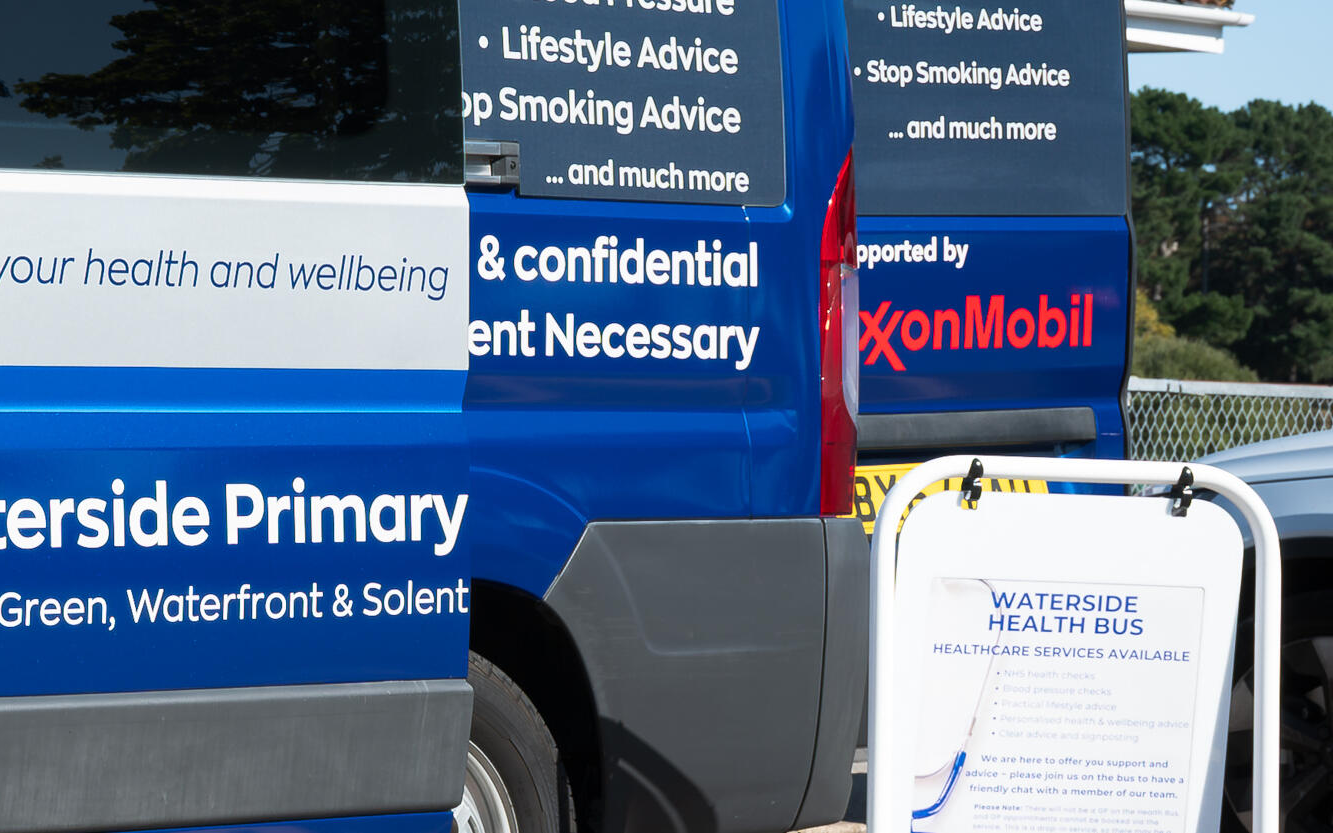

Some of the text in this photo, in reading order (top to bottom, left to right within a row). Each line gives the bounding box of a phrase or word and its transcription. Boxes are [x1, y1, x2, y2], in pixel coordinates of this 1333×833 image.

[890, 5, 1042, 34] Lifestyle Advice
[501, 24, 739, 74] Lifestyle Advice
[867, 59, 1070, 90] Stop Smoking Advice
[499, 86, 633, 135] Smoking
[639, 96, 741, 133] Advice
[907, 115, 945, 139] and
[949, 116, 1002, 139] much
[1006, 122, 1057, 141] more
[567, 159, 614, 186] and
[619, 162, 684, 189] much
[688, 170, 750, 192] more
[477, 234, 758, 287] & confidential
[943, 236, 969, 269] by
[84, 248, 198, 287] health
[210, 253, 279, 288] and
[289, 255, 449, 301] wellbeing
[545, 312, 761, 370] Necessary
[225, 477, 469, 556] Primary
[126, 582, 324, 625] Waterfront
[333, 584, 354, 617] &
[363, 578, 469, 616] Solent
[991, 592, 1138, 613] WATERSIDE
[988, 614, 1144, 635] HEALTH BUS
[933, 643, 1190, 661] HEALTHCARE SERVICES AVAILABLE
[1004, 670, 1096, 680] NHS health checks
[1003, 685, 1112, 696] Blood pressure checks
[1001, 700, 1117, 711] Practical lifestyle advice
[1000, 715, 1189, 729] Personalised health & wellbeing advice
[1027, 731, 1057, 739] advice
[1060, 732, 1079, 740] and
[1082, 733, 1139, 743] signposting
[981, 755, 998, 763] We
[1019, 756, 1042, 764] here
[1045, 757, 1055, 765] to
[1058, 757, 1082, 766] offer
[1107, 759, 1146, 768] support
[1149, 760, 1168, 768] and
[965, 769, 998, 778] advice
[1009, 771, 1042, 781] please
[1044, 771, 1064, 781] join
[1097, 773, 1114, 782] the
[1116, 774, 1135, 782] bus
[1138, 775, 1149, 783] to
[1151, 775, 1176, 784] have
[969, 784, 1008, 794] friendly
[1011, 785, 1033, 794] chat
[1036, 786, 1059, 795] with
[1071, 787, 1113, 797] member
[1116, 789, 1126, 797] of
[1149, 791, 1178, 799] team.
